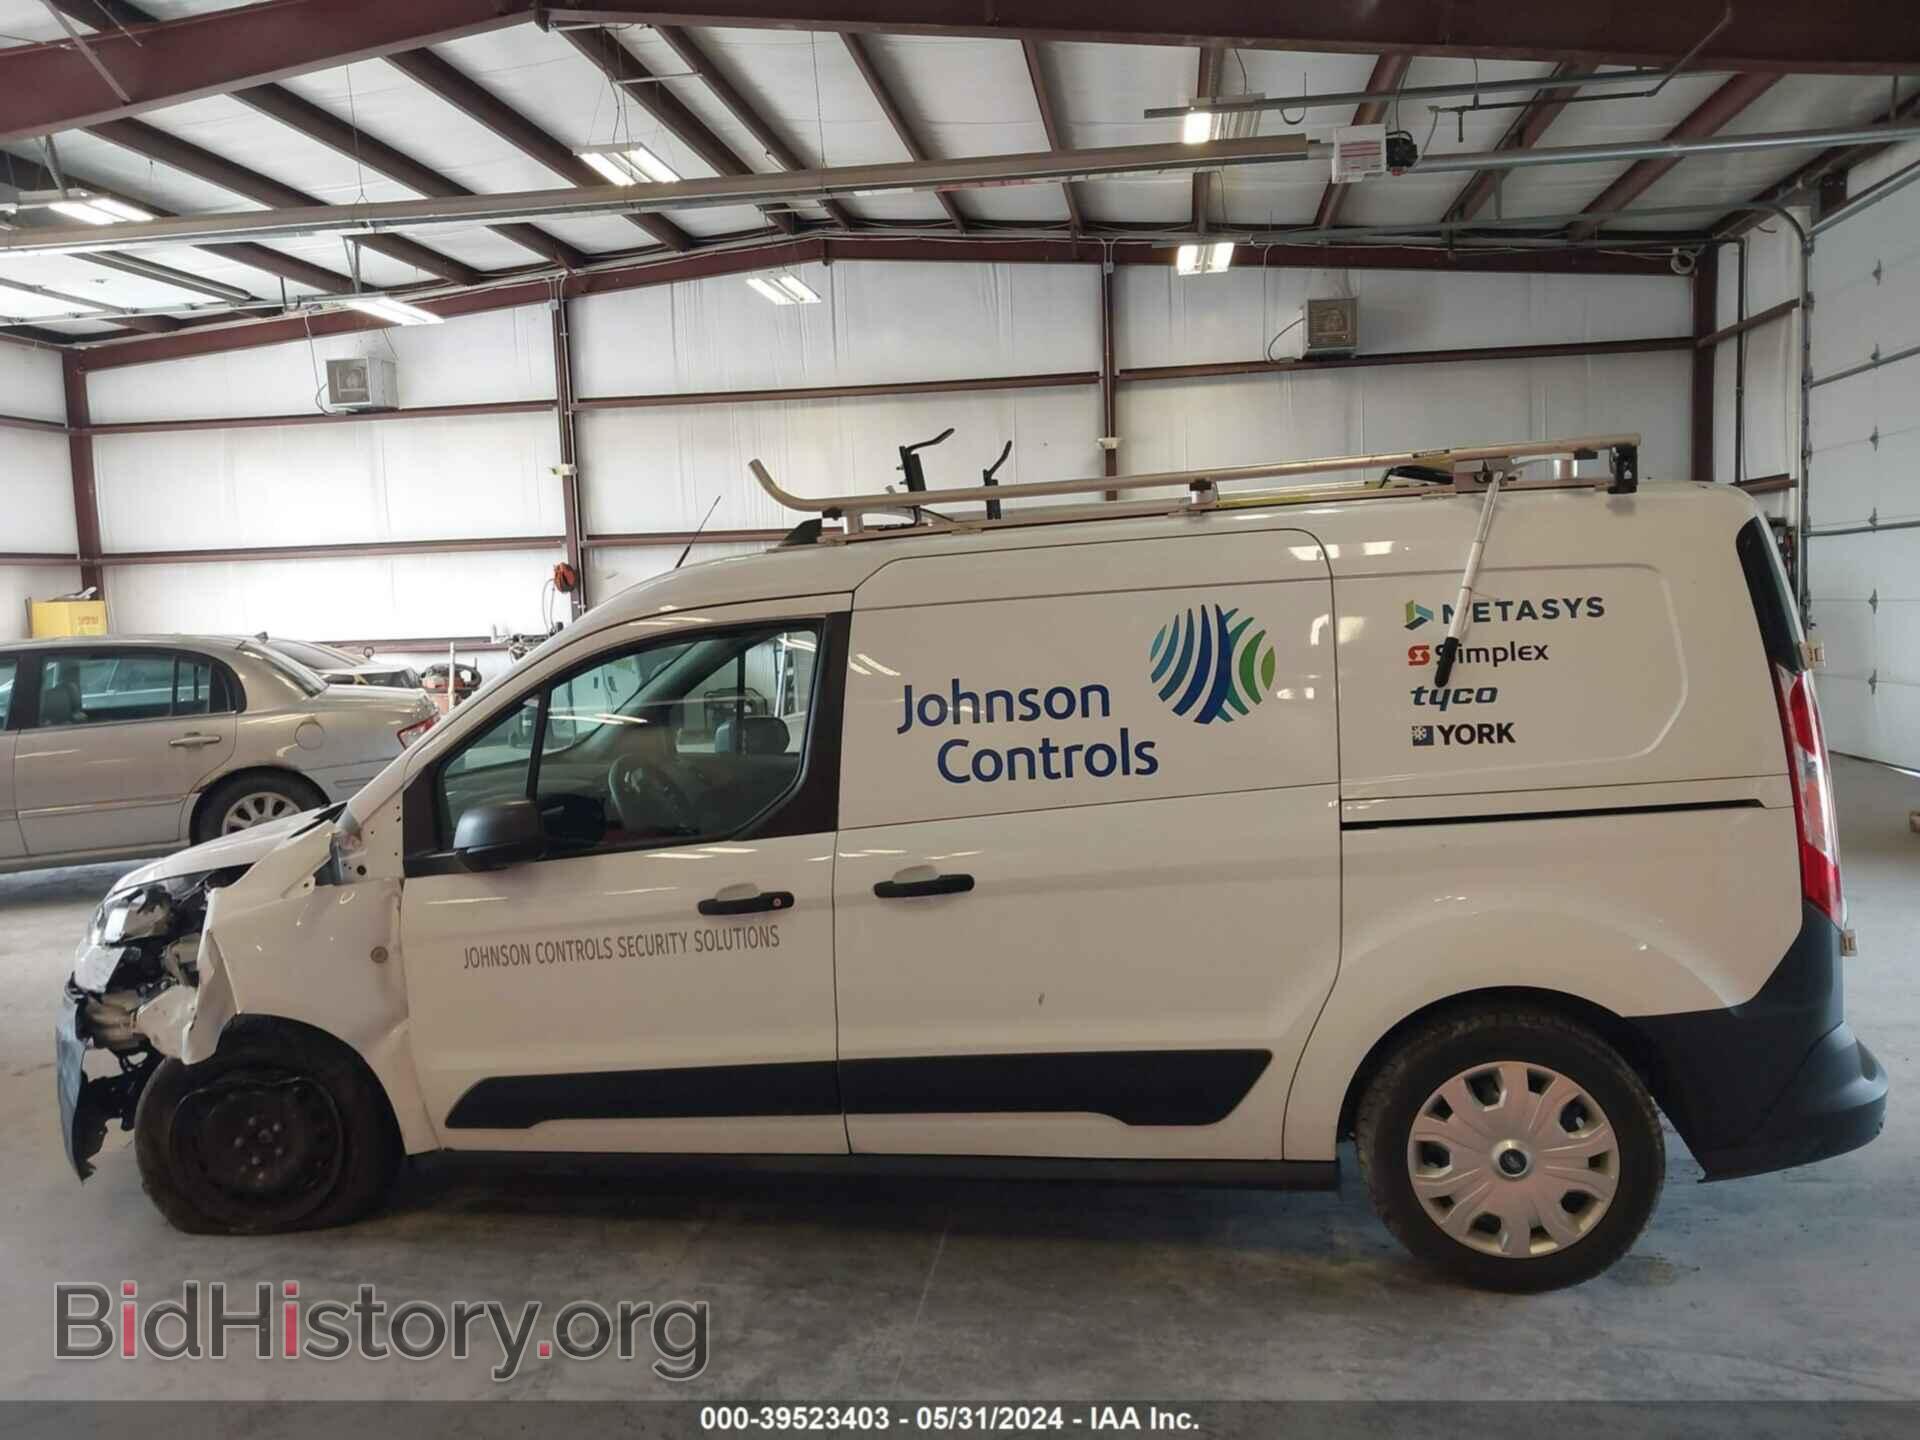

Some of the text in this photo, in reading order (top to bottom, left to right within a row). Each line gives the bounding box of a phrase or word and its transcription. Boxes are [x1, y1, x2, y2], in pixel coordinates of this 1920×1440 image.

[897, 678, 1110, 734] Johnson
[1410, 686, 1498, 711] tyco
[937, 728, 1159, 783] Controls
[1437, 722, 1516, 745] YORK
[463, 924, 780, 969] JOHNSON CONTROLS SECURITY SOLUTIONS
